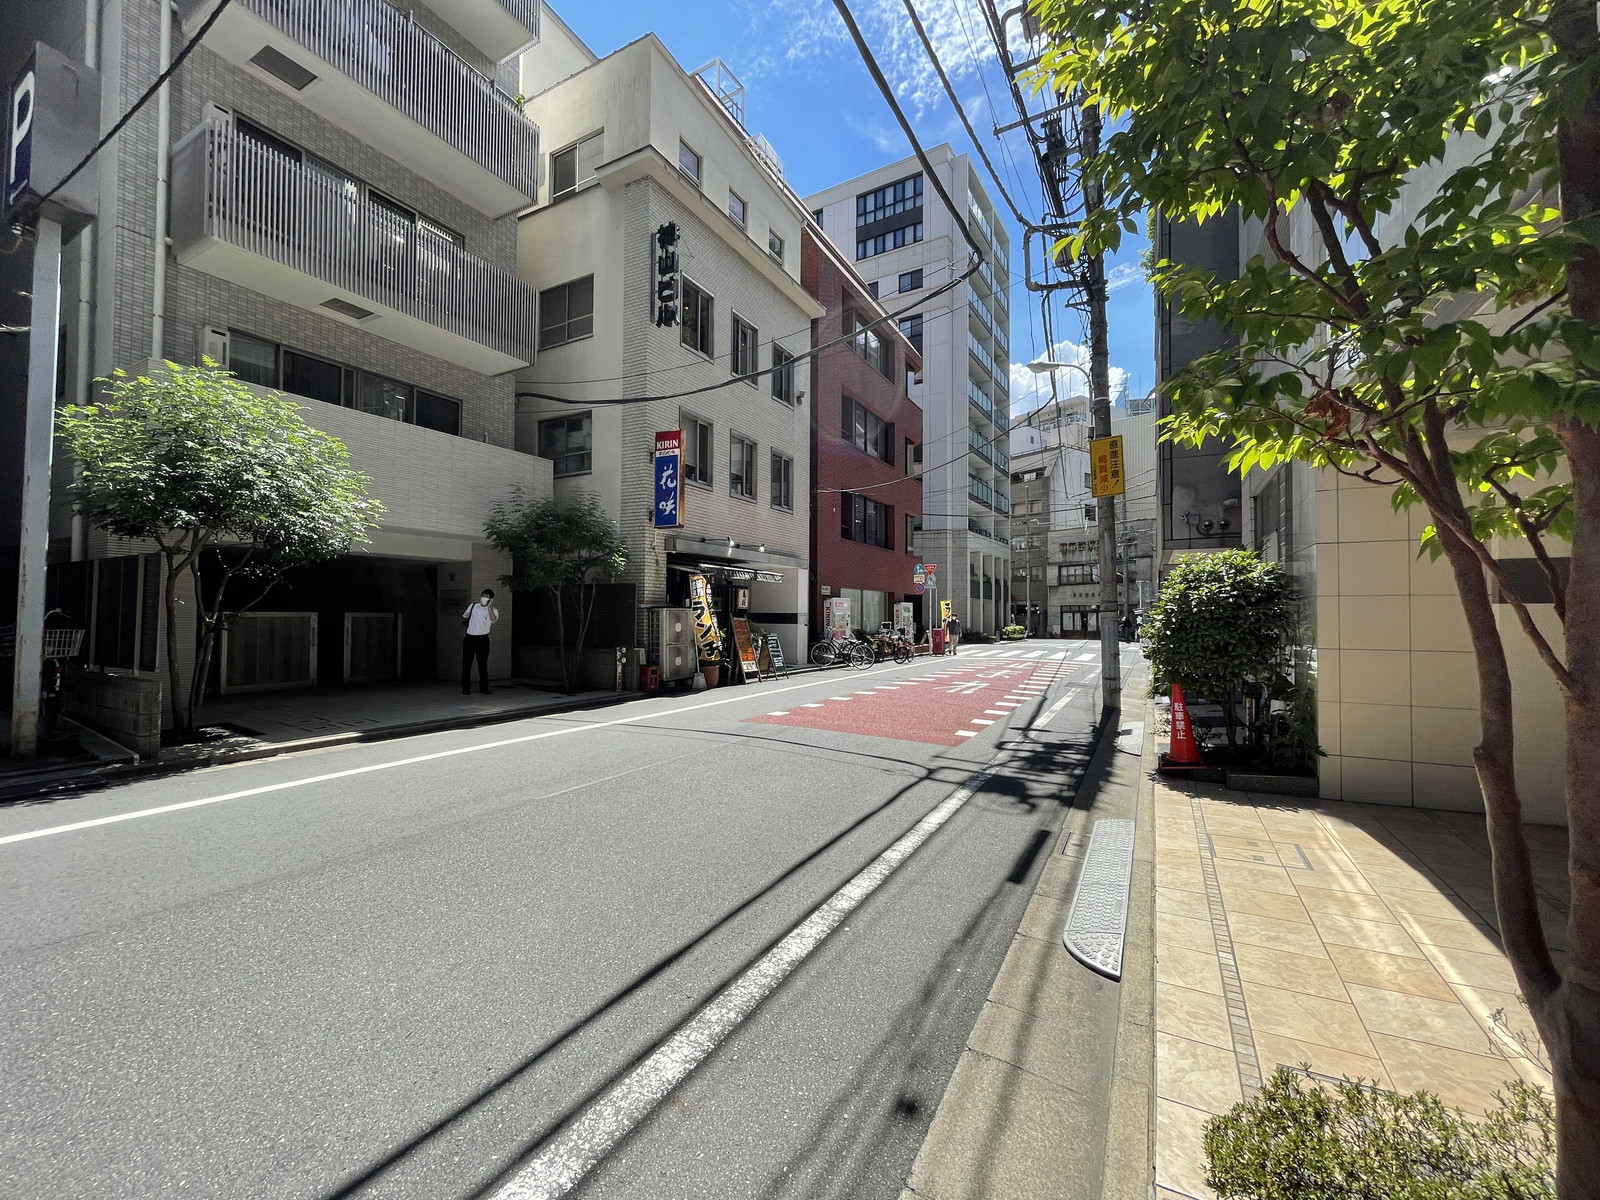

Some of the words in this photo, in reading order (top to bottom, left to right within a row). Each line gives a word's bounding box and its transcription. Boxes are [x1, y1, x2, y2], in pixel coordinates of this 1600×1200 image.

[10, 71, 35, 185] P
[656, 439, 679, 450] KIRIN
[659, 462, 677, 516] 花咲
[1098, 454, 1109, 494] 幅員減少
[692, 600, 720, 659] ランチ
[1173, 702, 1187, 740] 駐車禁止
